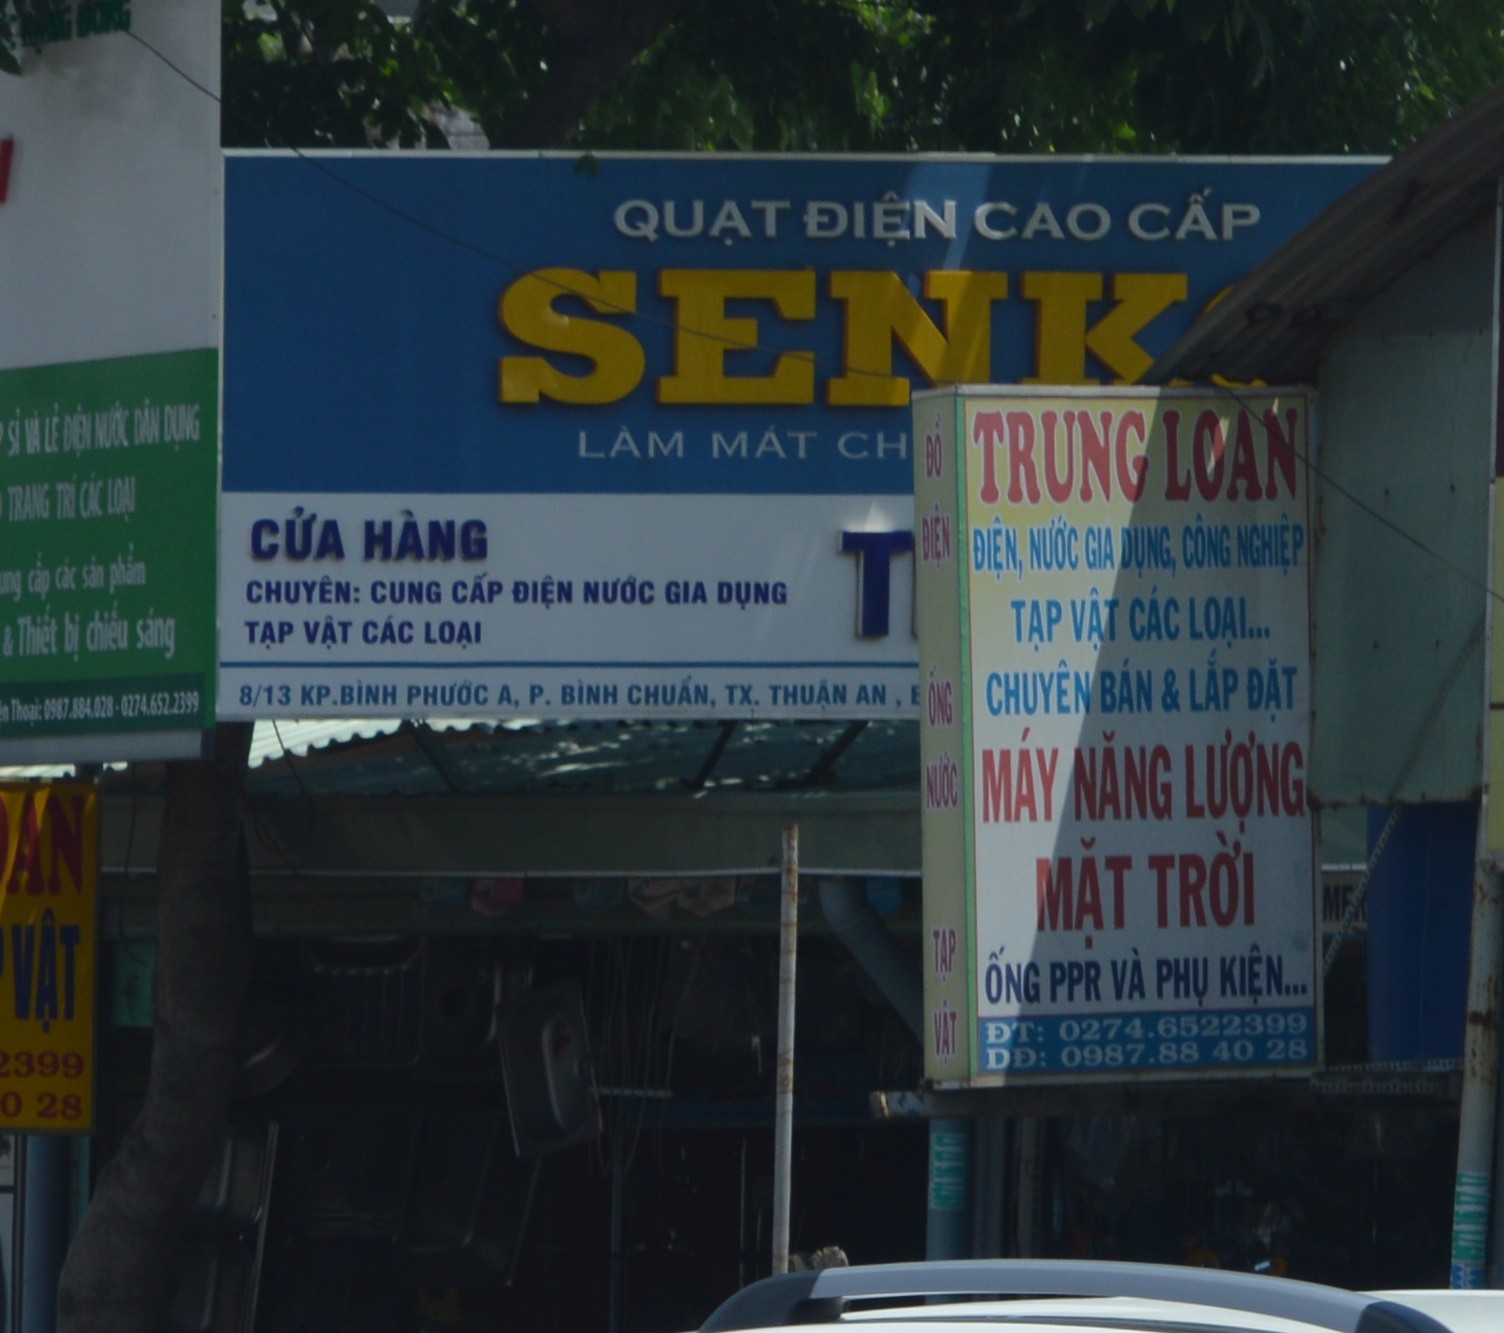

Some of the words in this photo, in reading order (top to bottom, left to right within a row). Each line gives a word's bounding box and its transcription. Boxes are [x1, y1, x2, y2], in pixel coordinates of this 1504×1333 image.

[612, 199, 792, 248] QUẠT
[803, 191, 959, 248] ĐIỆN
[974, 200, 1112, 241] CAO
[1125, 187, 1263, 241] CẤP
[578, 428, 685, 460] LÀM
[711, 429, 818, 460] MÁT
[973, 409, 1149, 504] TRUNG
[1161, 407, 1299, 502] LOAN
[250, 506, 345, 562] CỬA
[362, 509, 489, 562] HÀNG
[973, 514, 1024, 580] ĐIỆN,
[1029, 512, 1079, 572] NƯỚC
[1085, 526, 1115, 572] GIA
[1121, 523, 1177, 580] DỤNG,
[1181, 512, 1231, 570] CÔNG
[1236, 511, 1305, 576] NGHIỆP
[246, 575, 361, 606] CHUYÊN:
[369, 580, 443, 606] CUNG
[451, 571, 504, 605] CẤP
[512, 575, 574, 610] ĐIỆN
[583, 575, 656, 606] NƯỚC
[665, 580, 708, 606] GIA
[717, 580, 789, 611] DỤNG
[1010, 599, 1062, 653] TẠP
[1070, 586, 1120, 652] VẬT
[1128, 584, 1180, 642] CÁC
[244, 619, 295, 650] TẠP
[303, 615, 353, 650] VẬT
[361, 614, 415, 646] CÁC
[424, 619, 483, 651] LOẠI
[239, 683, 292, 708] 8/13
[300, 679, 398, 707] KP.BÌNH
[406, 680, 489, 707] PHƯỚC
[560, 679, 618, 707] BÌNH
[725, 684, 760, 706] TX.
[768, 679, 847, 712] THUẬN
[855, 684, 887, 706] AN
[986, 660, 1091, 717] CHUYÊN
[1100, 657, 1153, 716] BÁN
[1161, 671, 1181, 714] &
[1188, 648, 1239, 713] LẮP
[1247, 656, 1298, 723] ĐẶT
[981, 727, 1060, 824] MÁY
[1073, 730, 1173, 823] NĂNG
[1185, 729, 1307, 835] LƯỢNG
[1035, 837, 1133, 950] MẶT
[1148, 831, 1256, 930] TRỜI
[11, 907, 81, 1033] VẬT
[984, 945, 1041, 1005] ỐNG
[1049, 959, 1103, 1003] PPR
[1111, 947, 1146, 1001] VÀ
[1156, 956, 1209, 1008] PHỤ
[985, 1020, 1046, 1045] ĐT:
[1058, 1012, 1308, 1043] 0274.6522399
[985, 1046, 1047, 1070] DĐ:
[1059, 1039, 1200, 1069] 0987.88
[1212, 1039, 1253, 1063] 40
[1266, 1038, 1308, 1060] 28
[35, 1092, 83, 1121] 28
